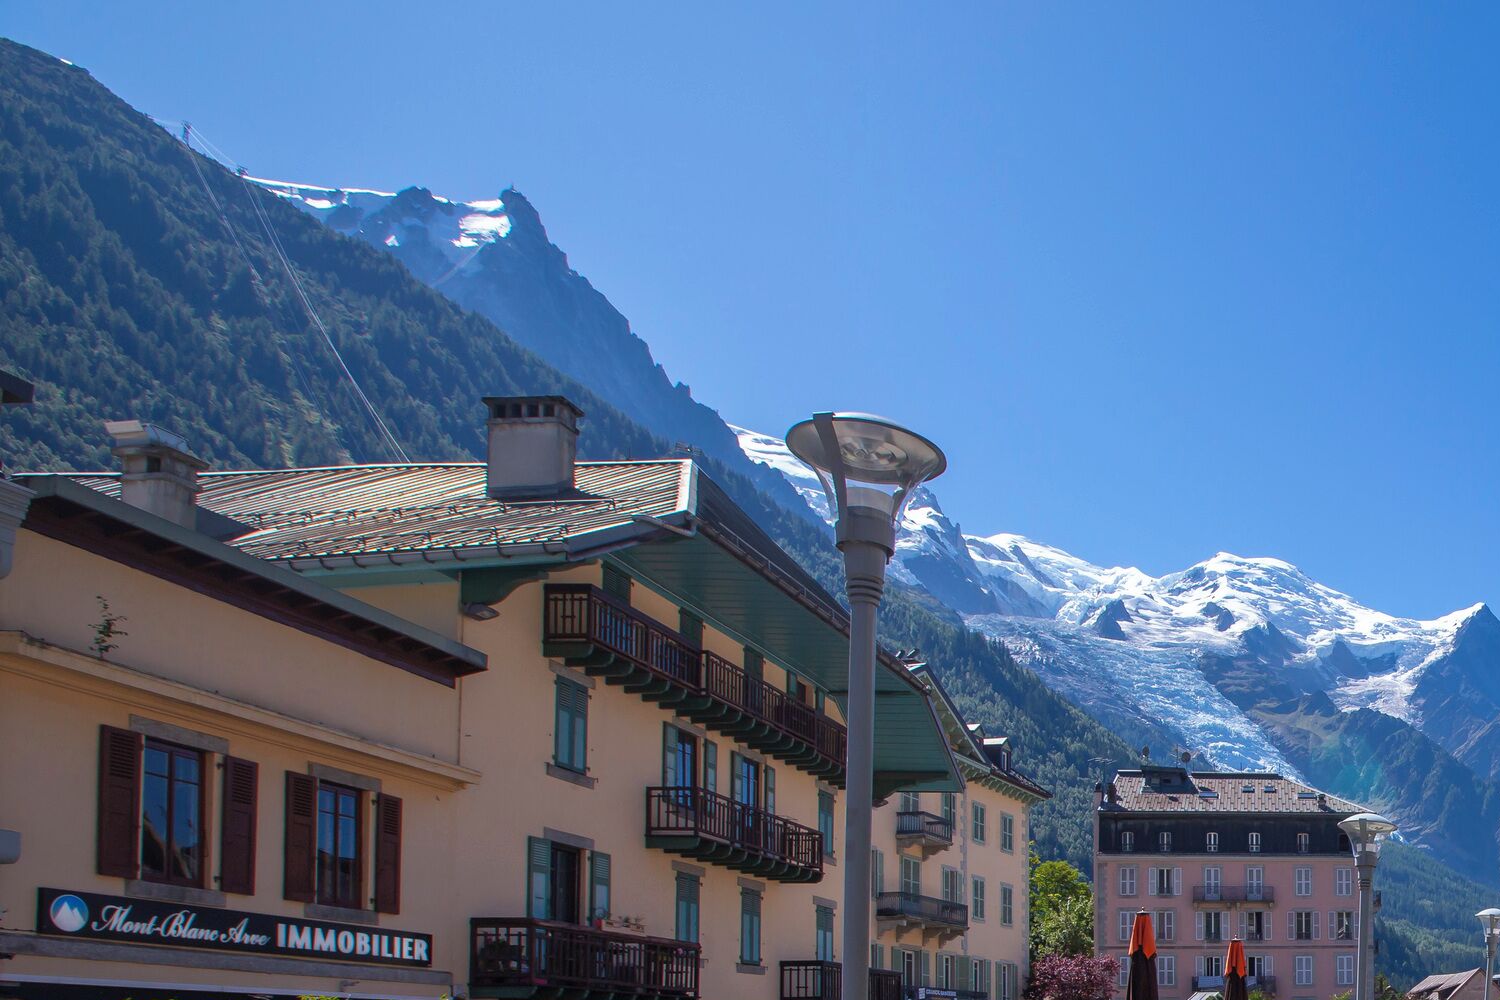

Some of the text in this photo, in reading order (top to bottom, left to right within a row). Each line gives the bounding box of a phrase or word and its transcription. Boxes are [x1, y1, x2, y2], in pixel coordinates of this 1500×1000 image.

[91, 904, 430, 962] Mont-Blanc Arve IMMOBILIER
